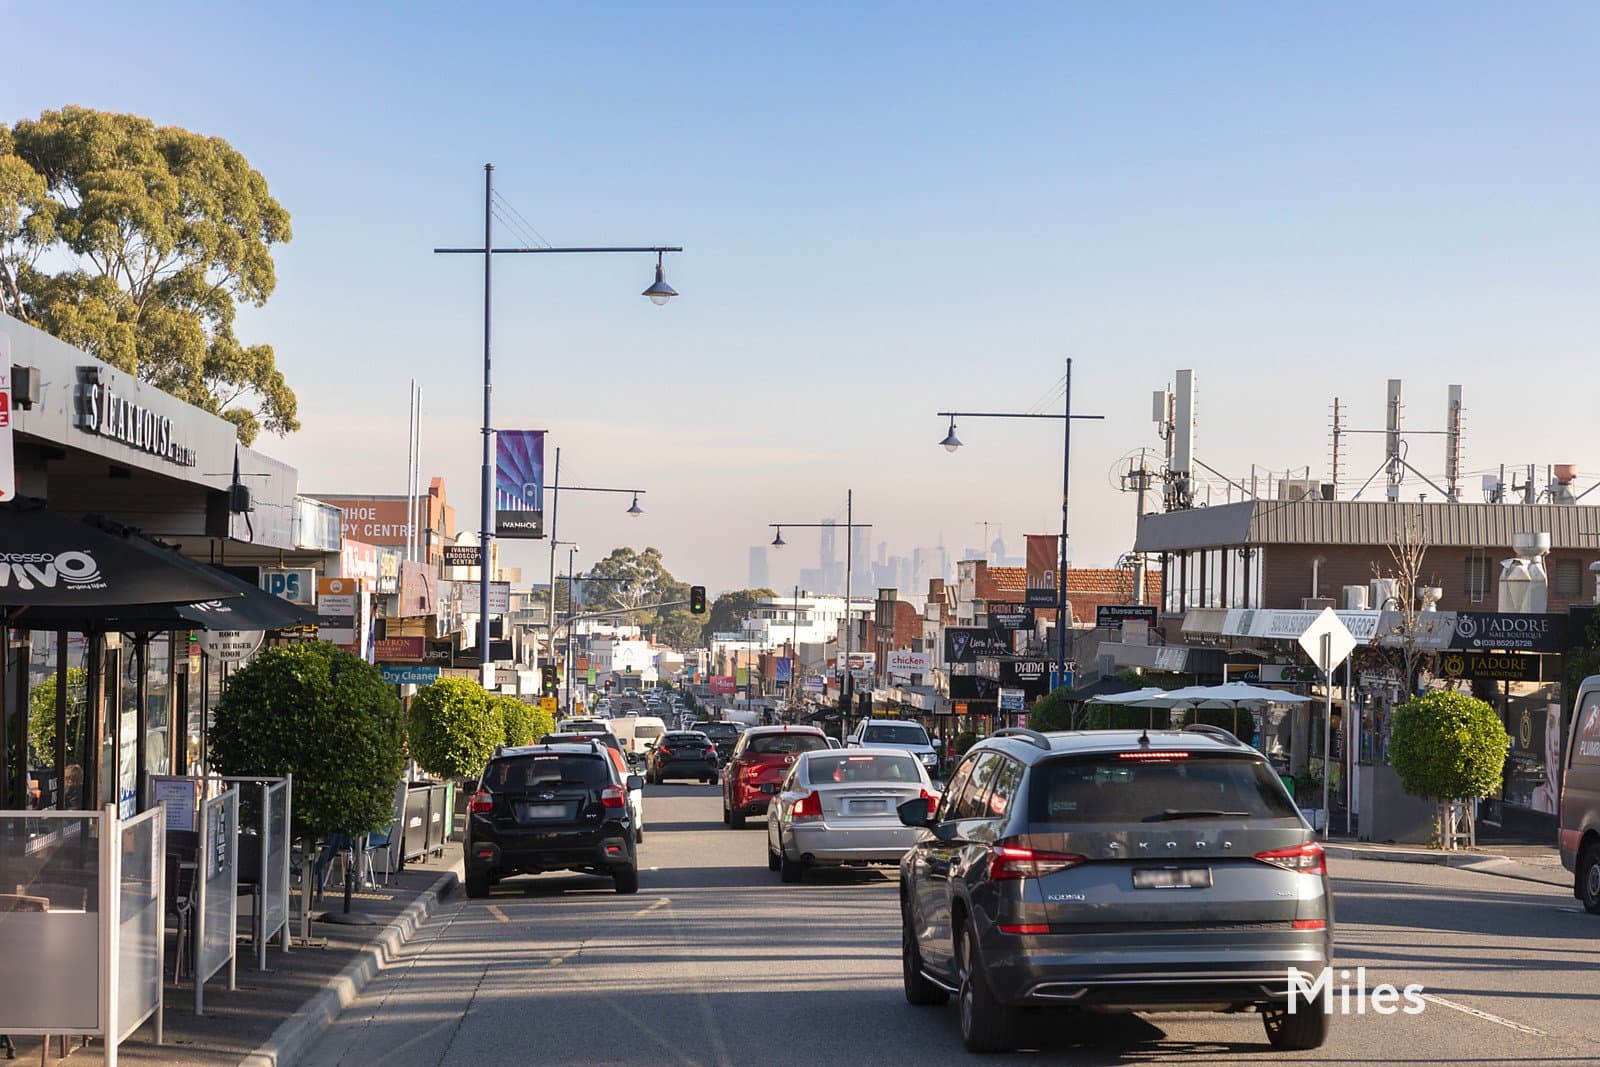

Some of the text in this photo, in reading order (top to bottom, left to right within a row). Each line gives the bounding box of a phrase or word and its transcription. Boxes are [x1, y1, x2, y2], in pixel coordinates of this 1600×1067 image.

[1482, 617, 1549, 632] J'ADORE
[892, 655, 924, 665] chicken
[1471, 657, 1527, 670] J'ADORE
[1015, 662, 1044, 672] DAMA
[384, 672, 400, 681] Dry
